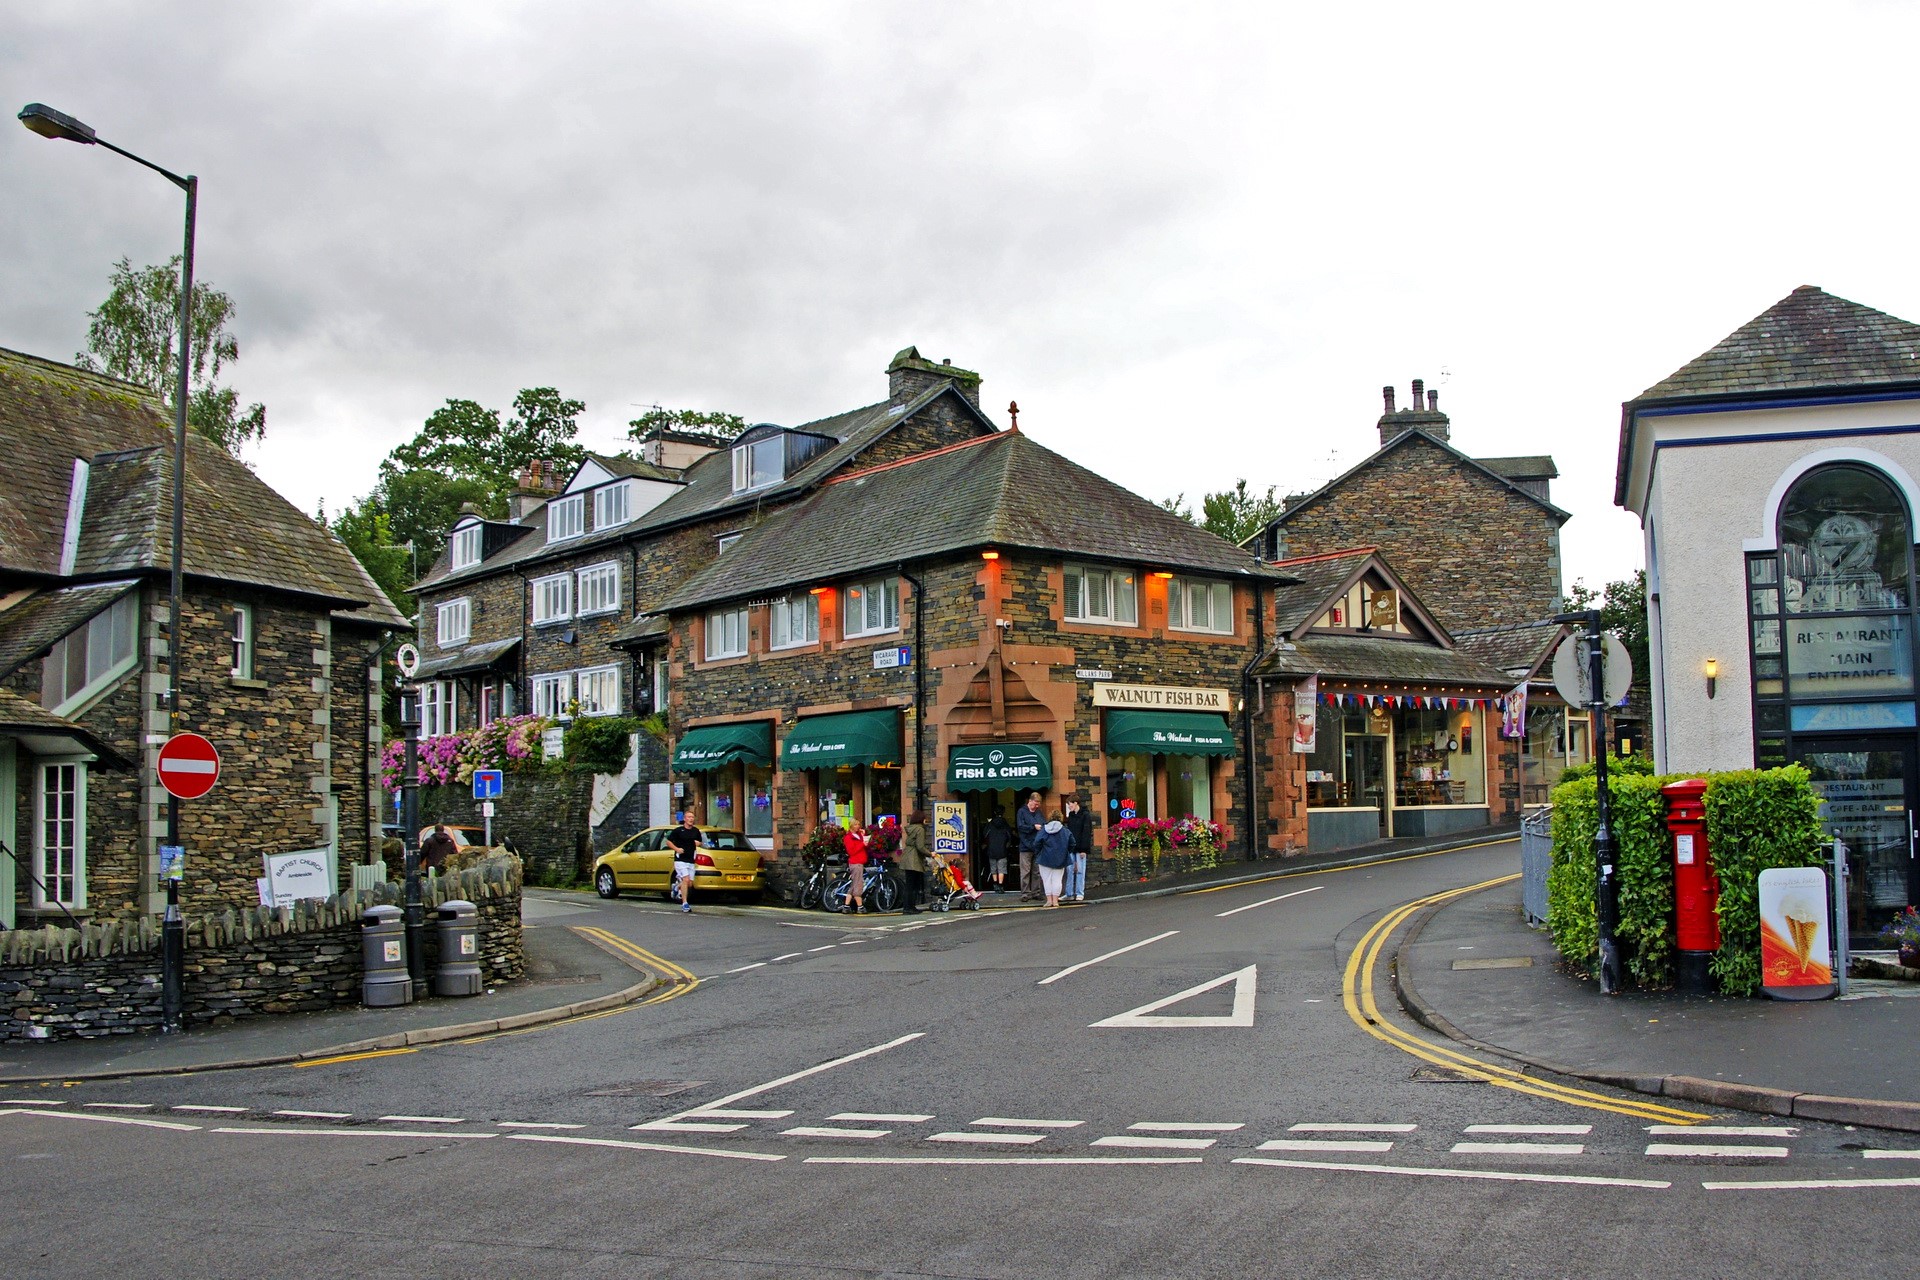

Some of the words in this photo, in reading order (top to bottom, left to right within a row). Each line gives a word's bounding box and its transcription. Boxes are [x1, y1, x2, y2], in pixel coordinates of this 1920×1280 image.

[875, 651, 897, 659] VICARAGE
[1831, 653, 1872, 665] MAIN
[1808, 669, 1896, 680] ENTRANCE
[1105, 688, 1162, 704] WALNUT
[1165, 691, 1192, 705] FISH
[1195, 693, 1219, 707] BAR
[1153, 731, 1166, 741] The
[1167, 731, 1192, 742] Walnut
[790, 744, 800, 754] The
[801, 743, 822, 753] Walnut
[955, 769, 984, 778] FISH
[987, 768, 997, 777] &
[1000, 766, 1038, 777] CHIPS
[1824, 783, 1885, 792] RESTAURANT
[937, 805, 962, 815] FISH
[1829, 804, 1854, 813] CAFE
[1862, 804, 1880, 812] BAR
[936, 829, 965, 839] CHIPS
[938, 840, 963, 850] OPEN
[275, 859, 297, 877] BAPTIST
[299, 859, 324, 873] CHURCH
